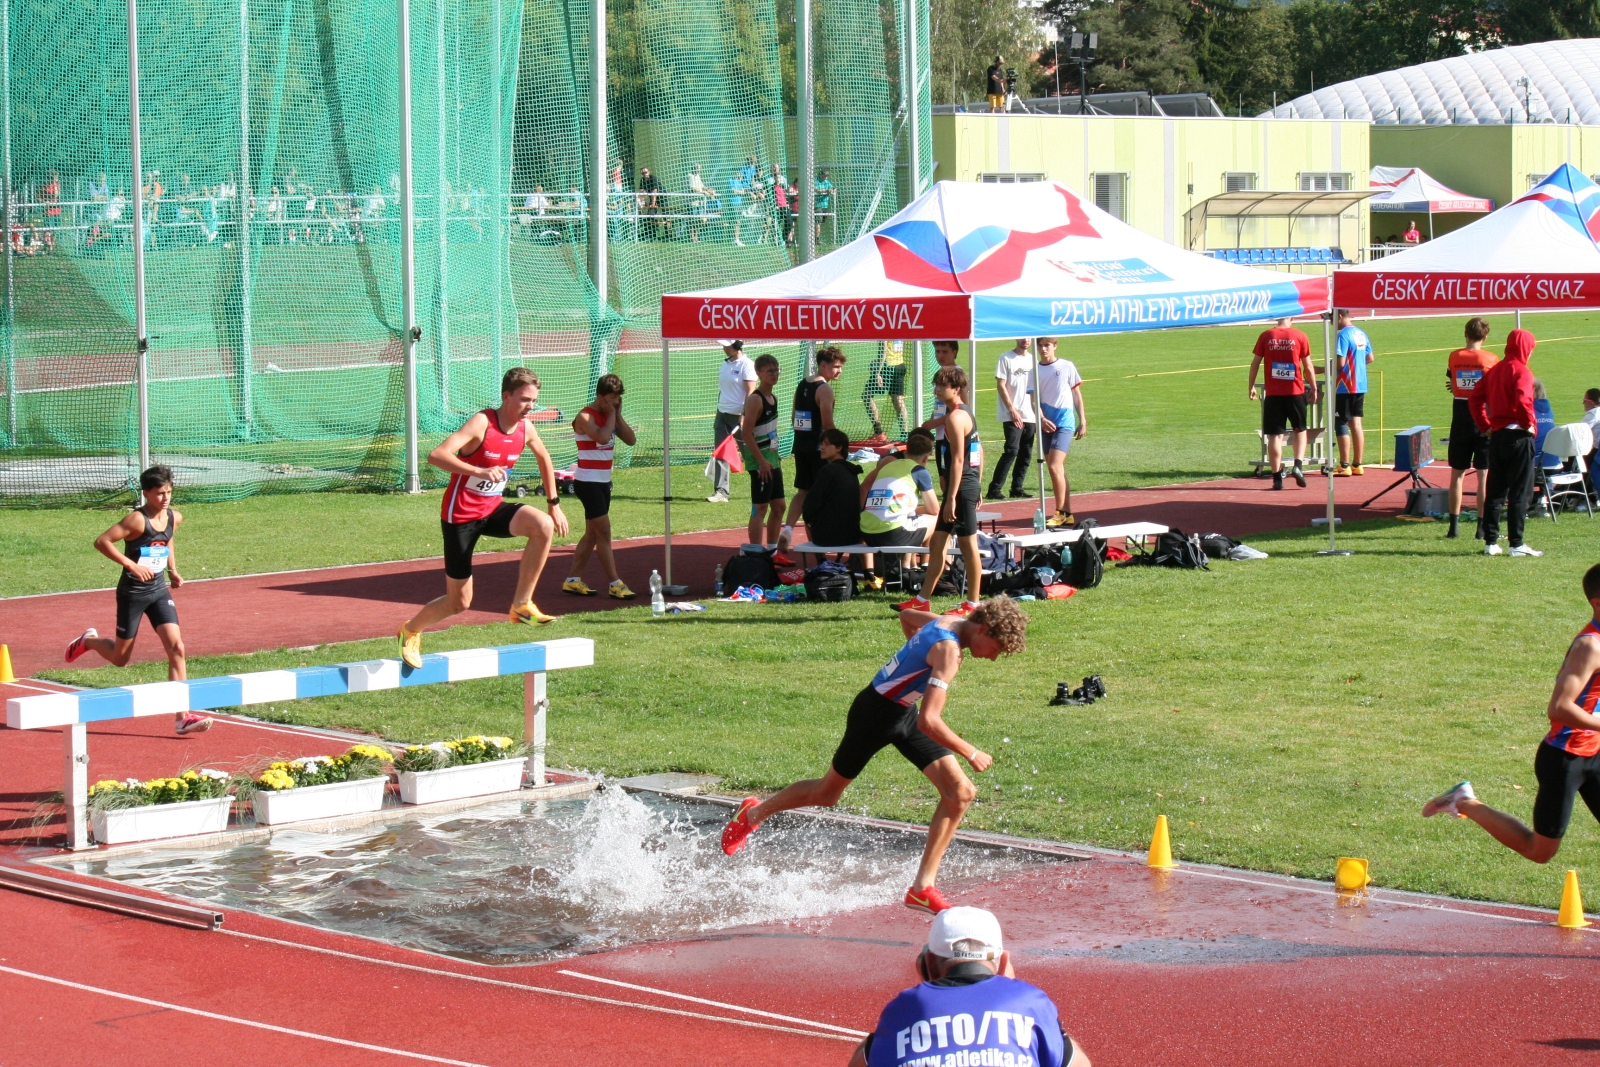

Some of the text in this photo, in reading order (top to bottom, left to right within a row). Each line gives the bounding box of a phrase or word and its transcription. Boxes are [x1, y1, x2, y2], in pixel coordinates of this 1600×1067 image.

[1372, 274, 1586, 300] ČESKÝ ATLETICKÝ SVAZ
[699, 299, 924, 330] ČESKÝ ATLETICKÝ SVAZ
[1050, 290, 1272, 326] CZECH ATHLETIC FEDERATION
[1461, 378, 1476, 387] 375
[871, 498, 883, 506] 121
[896, 1011, 1035, 1059] FOTO/TV
[897, 1048, 1034, 1067] ww.atletika.cz
